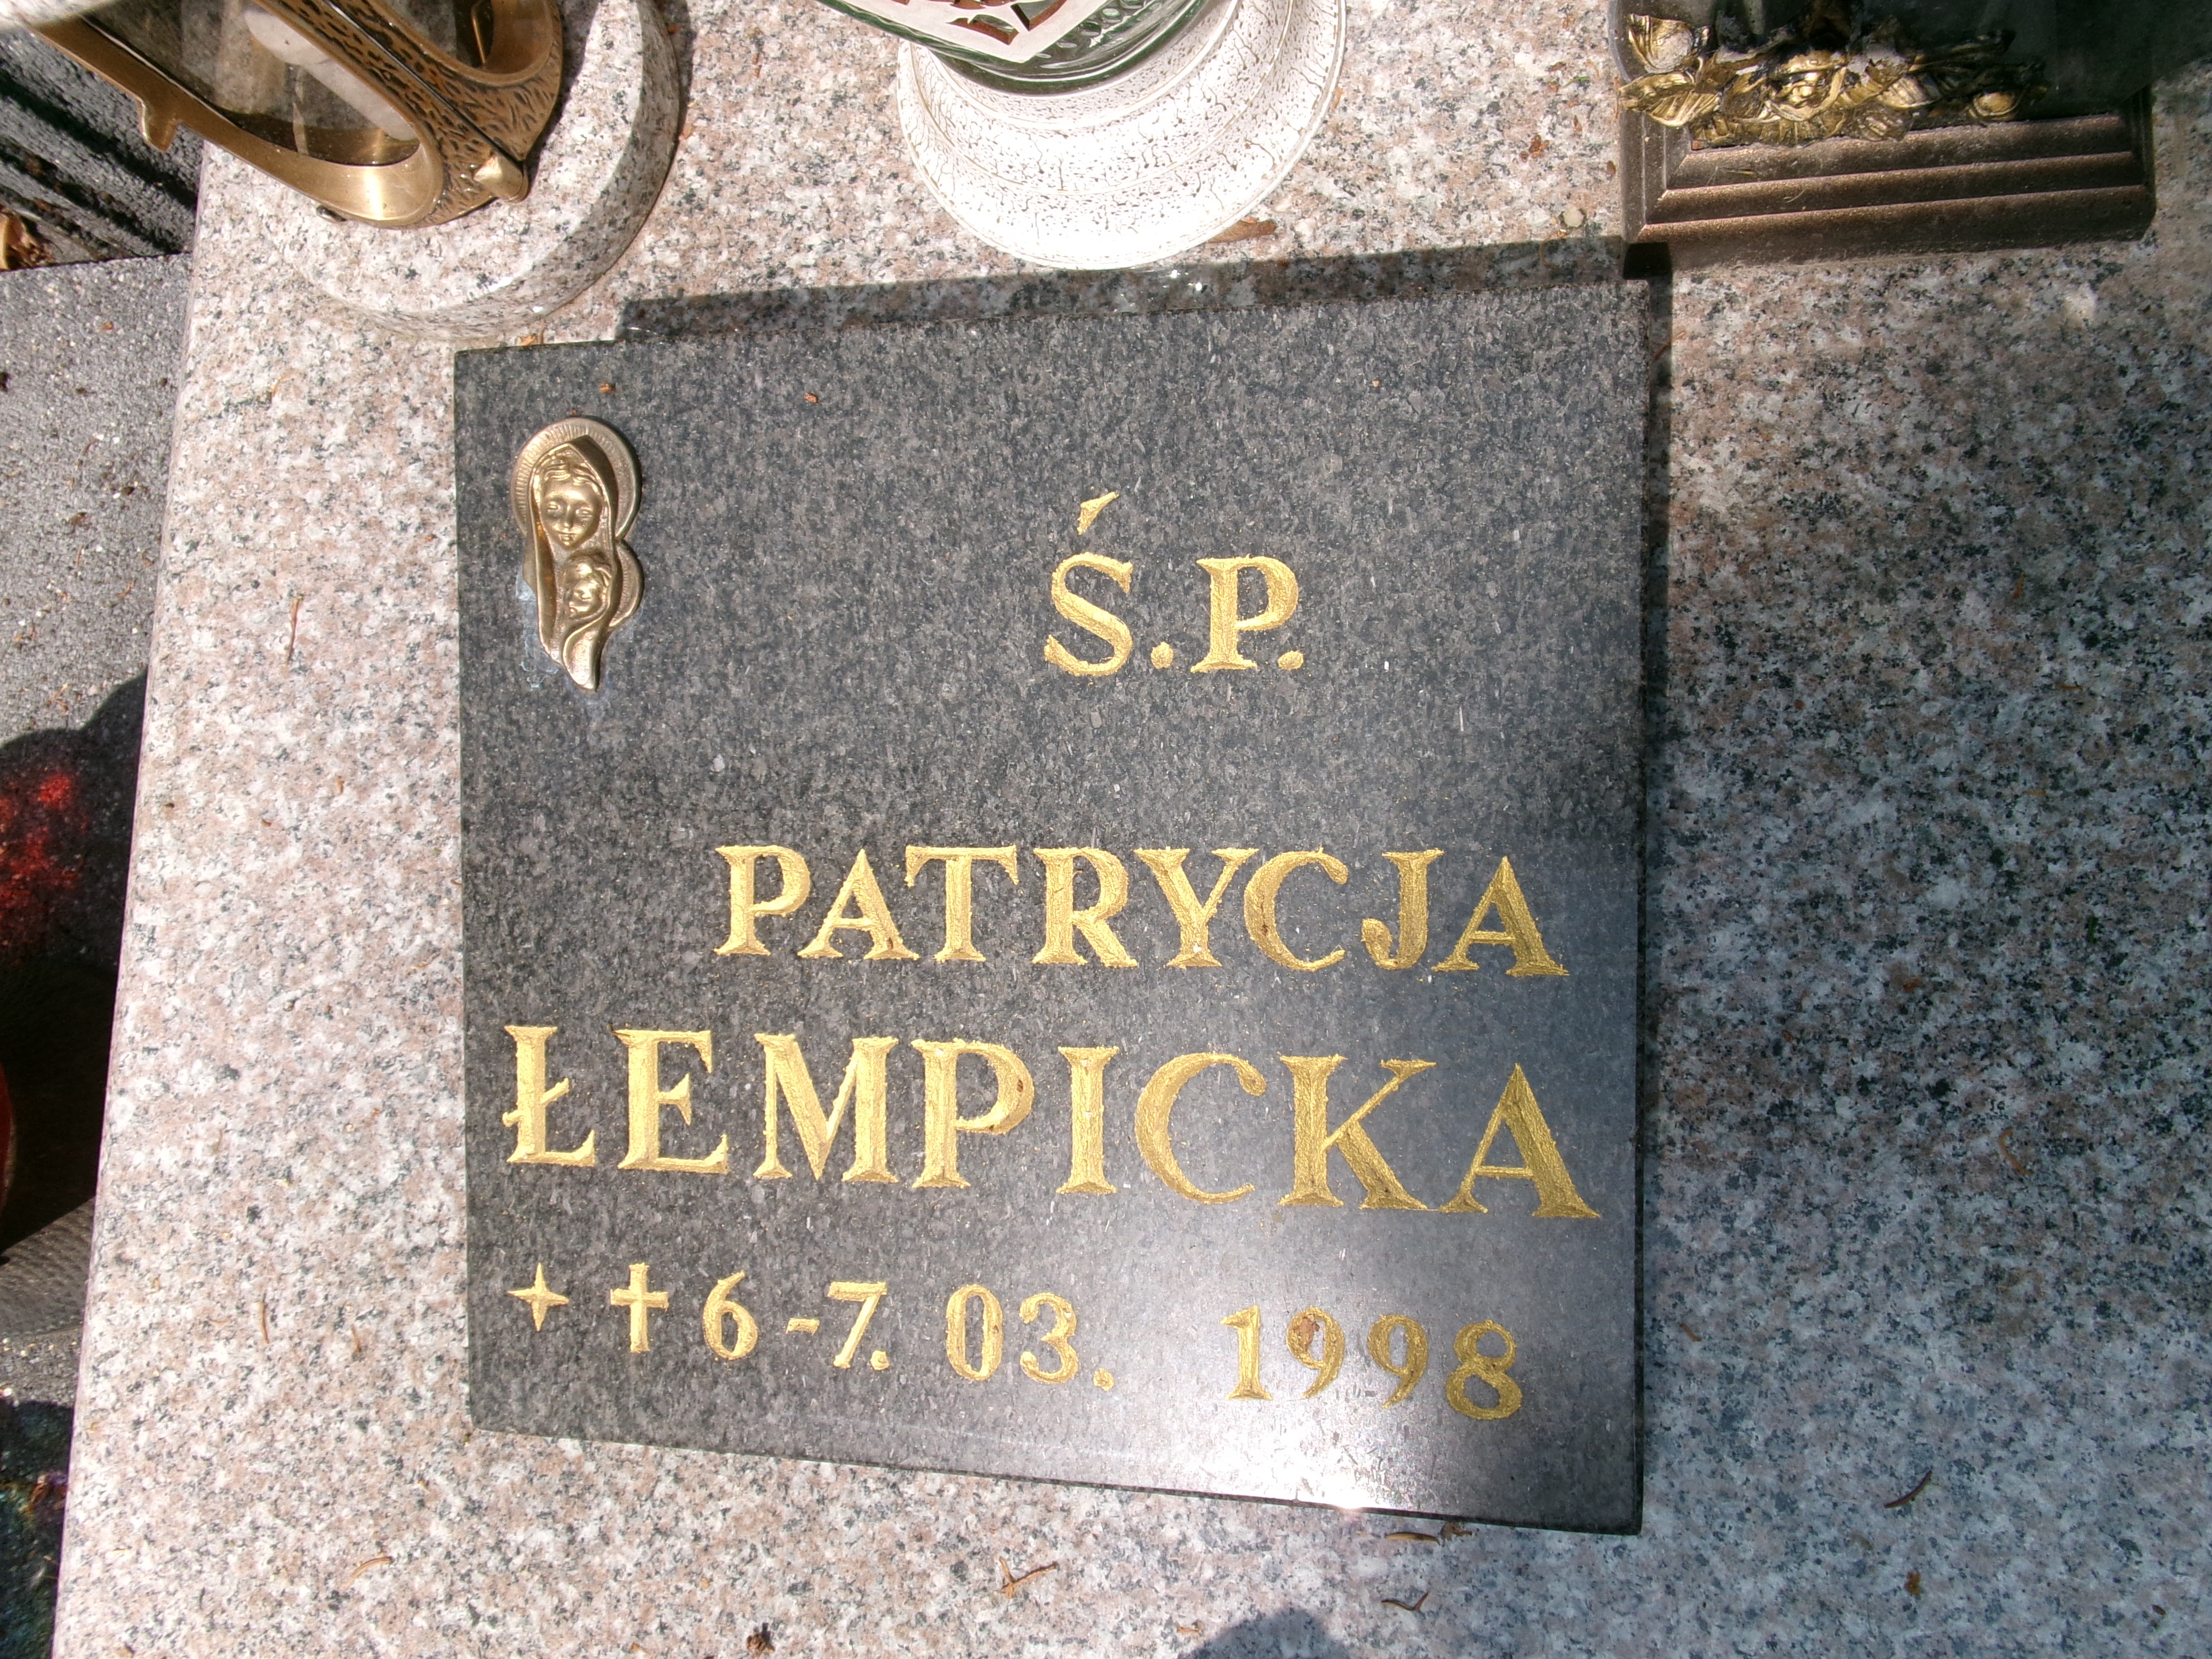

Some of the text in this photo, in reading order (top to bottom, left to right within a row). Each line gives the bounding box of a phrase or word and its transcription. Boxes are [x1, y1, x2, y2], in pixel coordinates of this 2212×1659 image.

[1044, 492, 1306, 678] Ś.P.
[713, 843, 1570, 976] PATRYCJA
[503, 1024, 1601, 1219] ŁEMPICKA
[945, 1283, 1115, 1392] 03.
[1220, 1304, 1522, 1421] 1998
